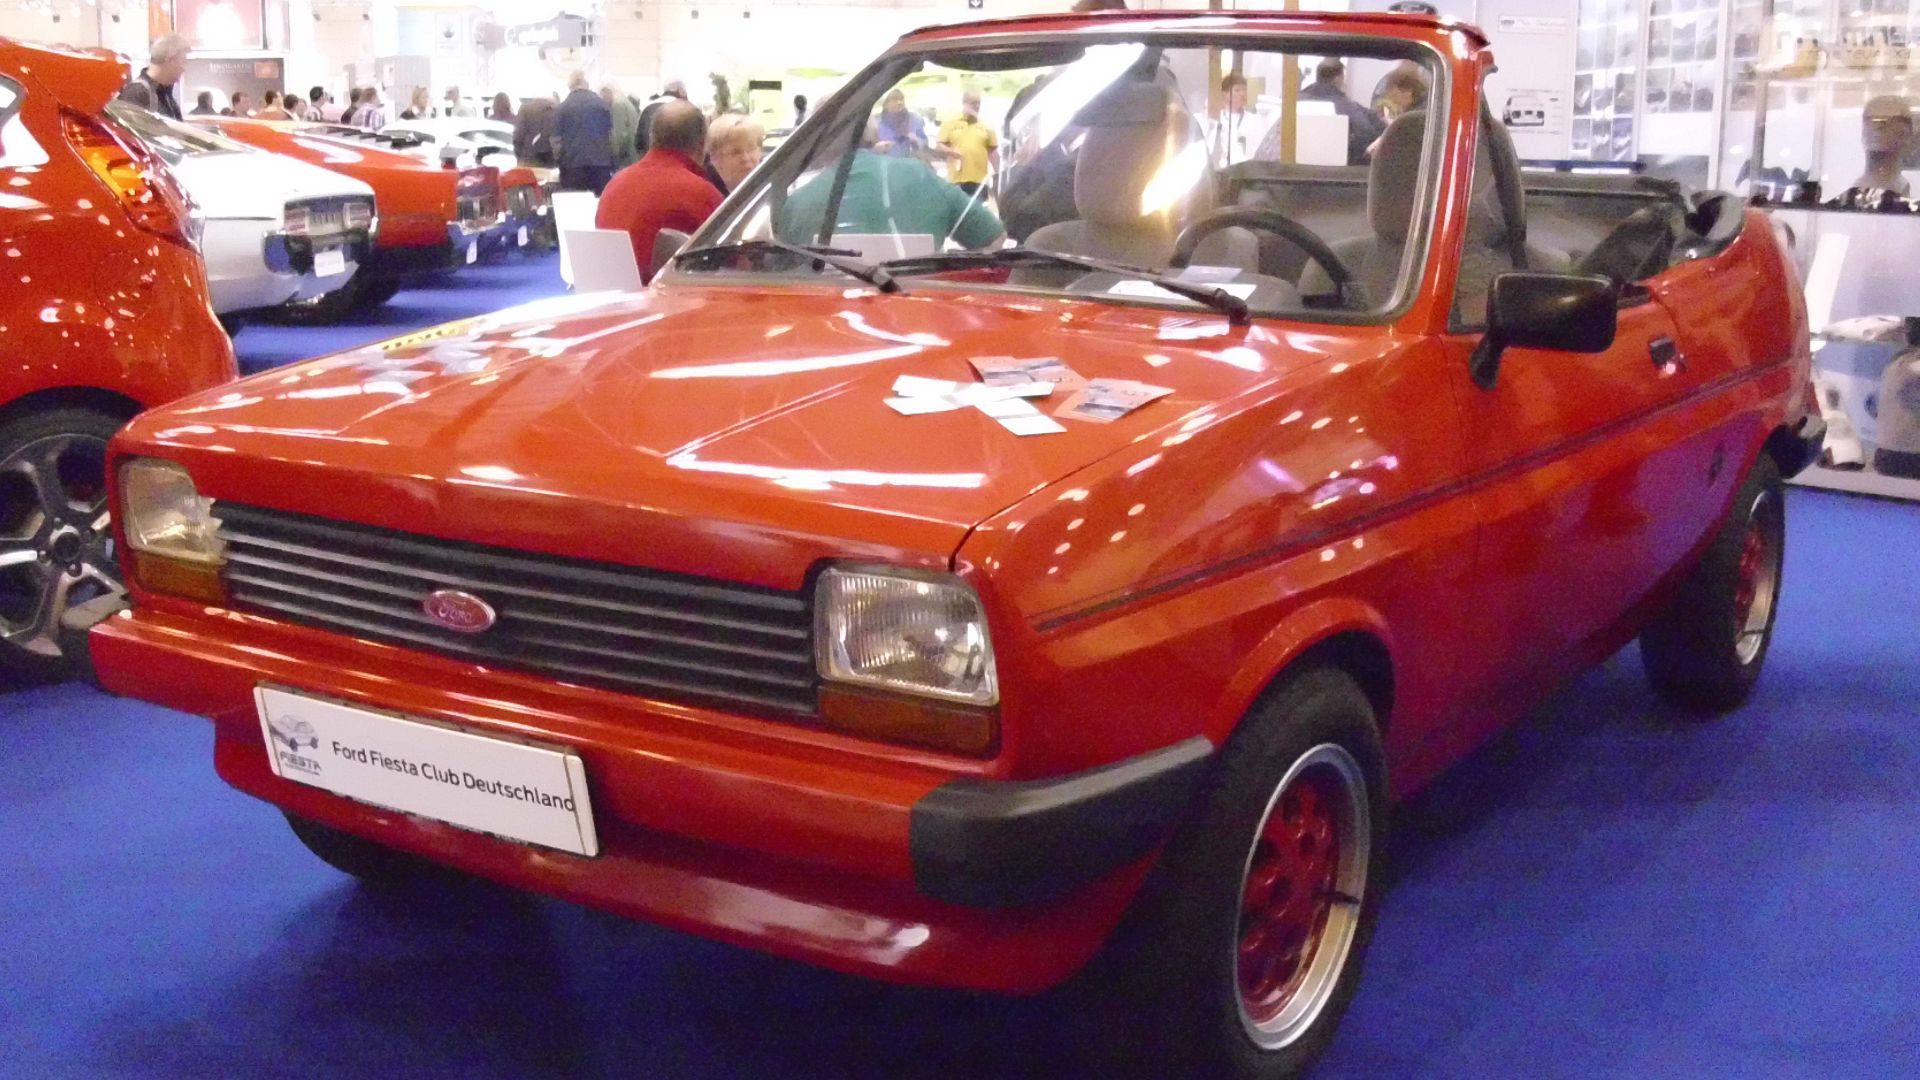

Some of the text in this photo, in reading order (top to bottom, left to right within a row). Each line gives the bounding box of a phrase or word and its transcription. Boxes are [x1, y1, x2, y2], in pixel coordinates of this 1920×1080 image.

[279, 750, 322, 771] FIESTA
[332, 741, 576, 813] Ford Fiesta Club Deutschland
